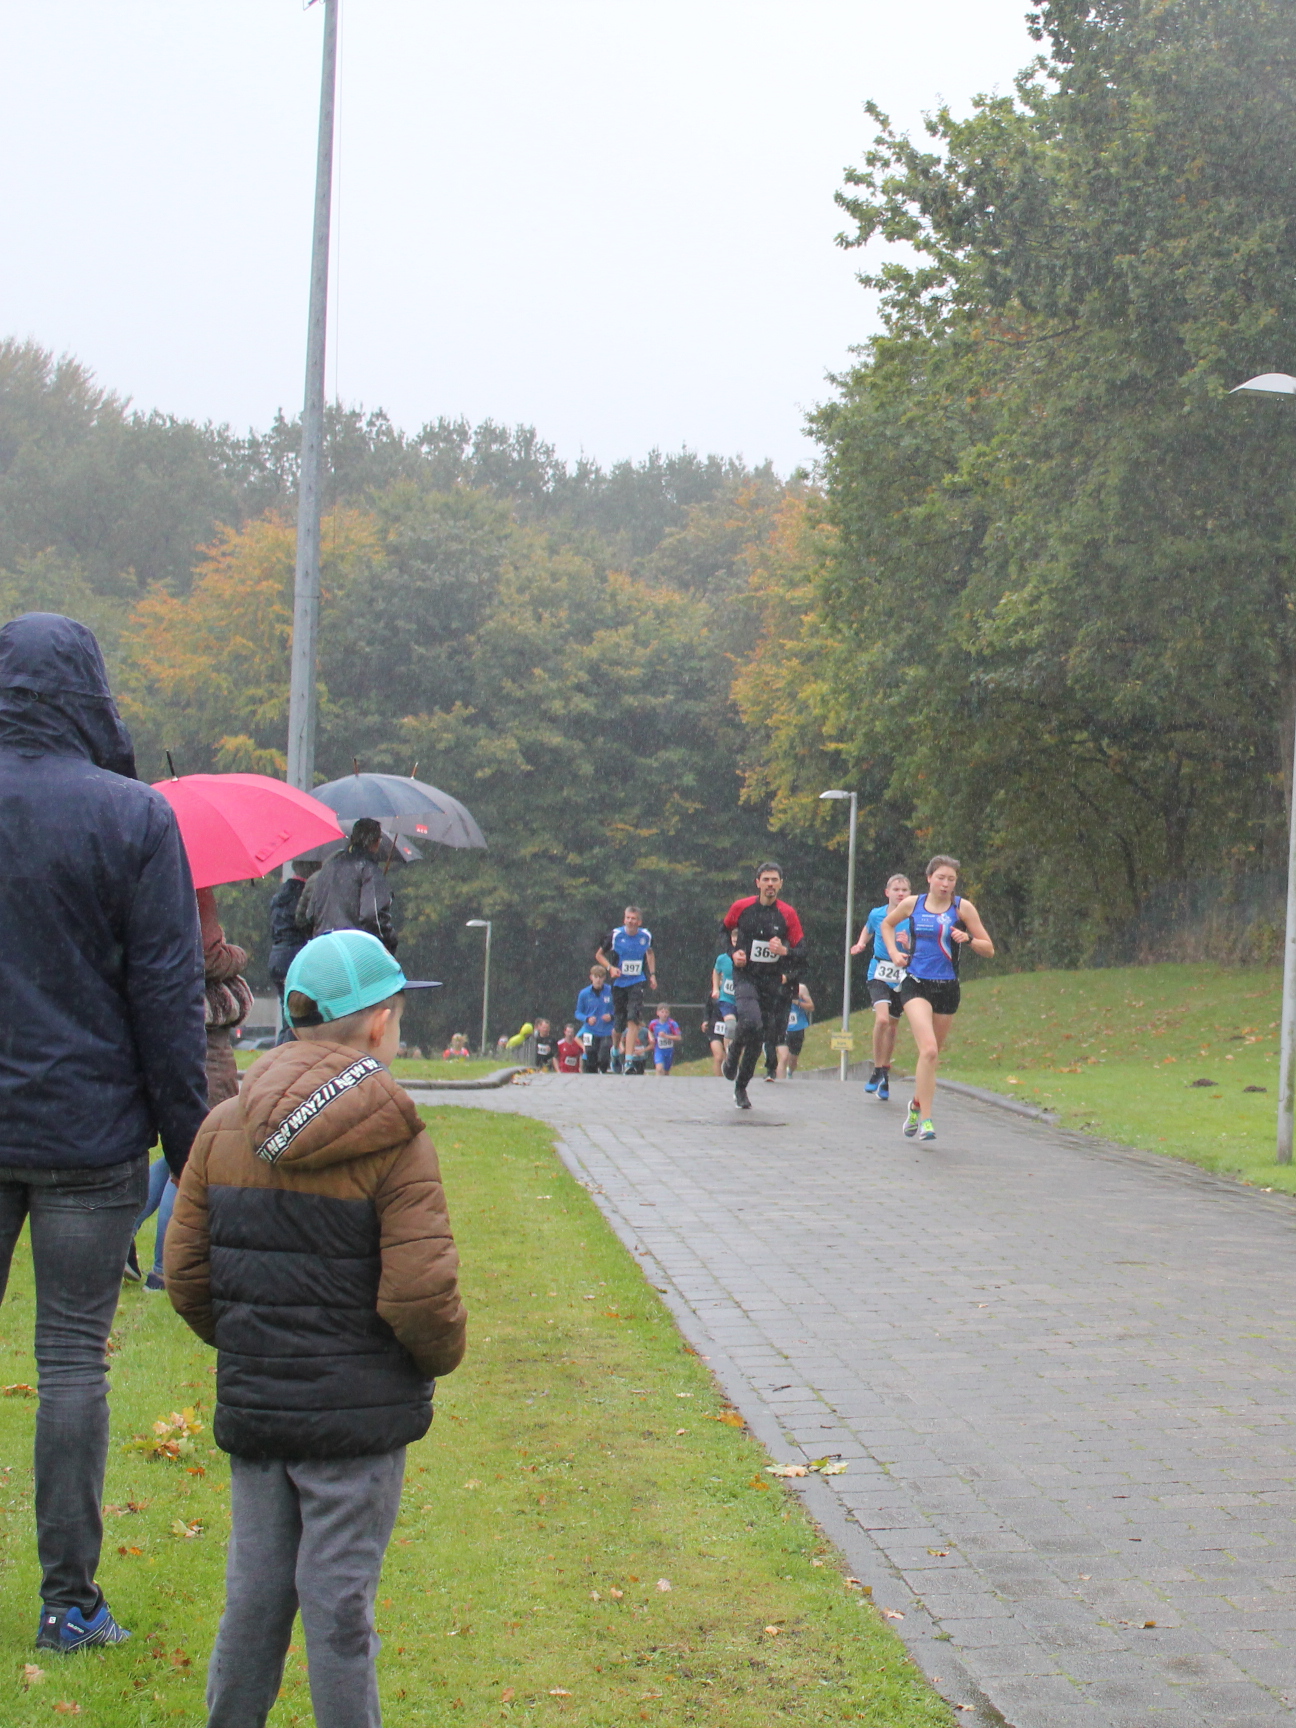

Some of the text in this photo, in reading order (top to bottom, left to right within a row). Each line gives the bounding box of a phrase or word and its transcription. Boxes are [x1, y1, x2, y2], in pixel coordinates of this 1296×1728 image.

[623, 963, 640, 973] 397
[878, 966, 900, 981] 324
[266, 1122, 291, 1156] NEW
[333, 1063, 366, 1090] NEW
[361, 1058, 379, 1070] W
